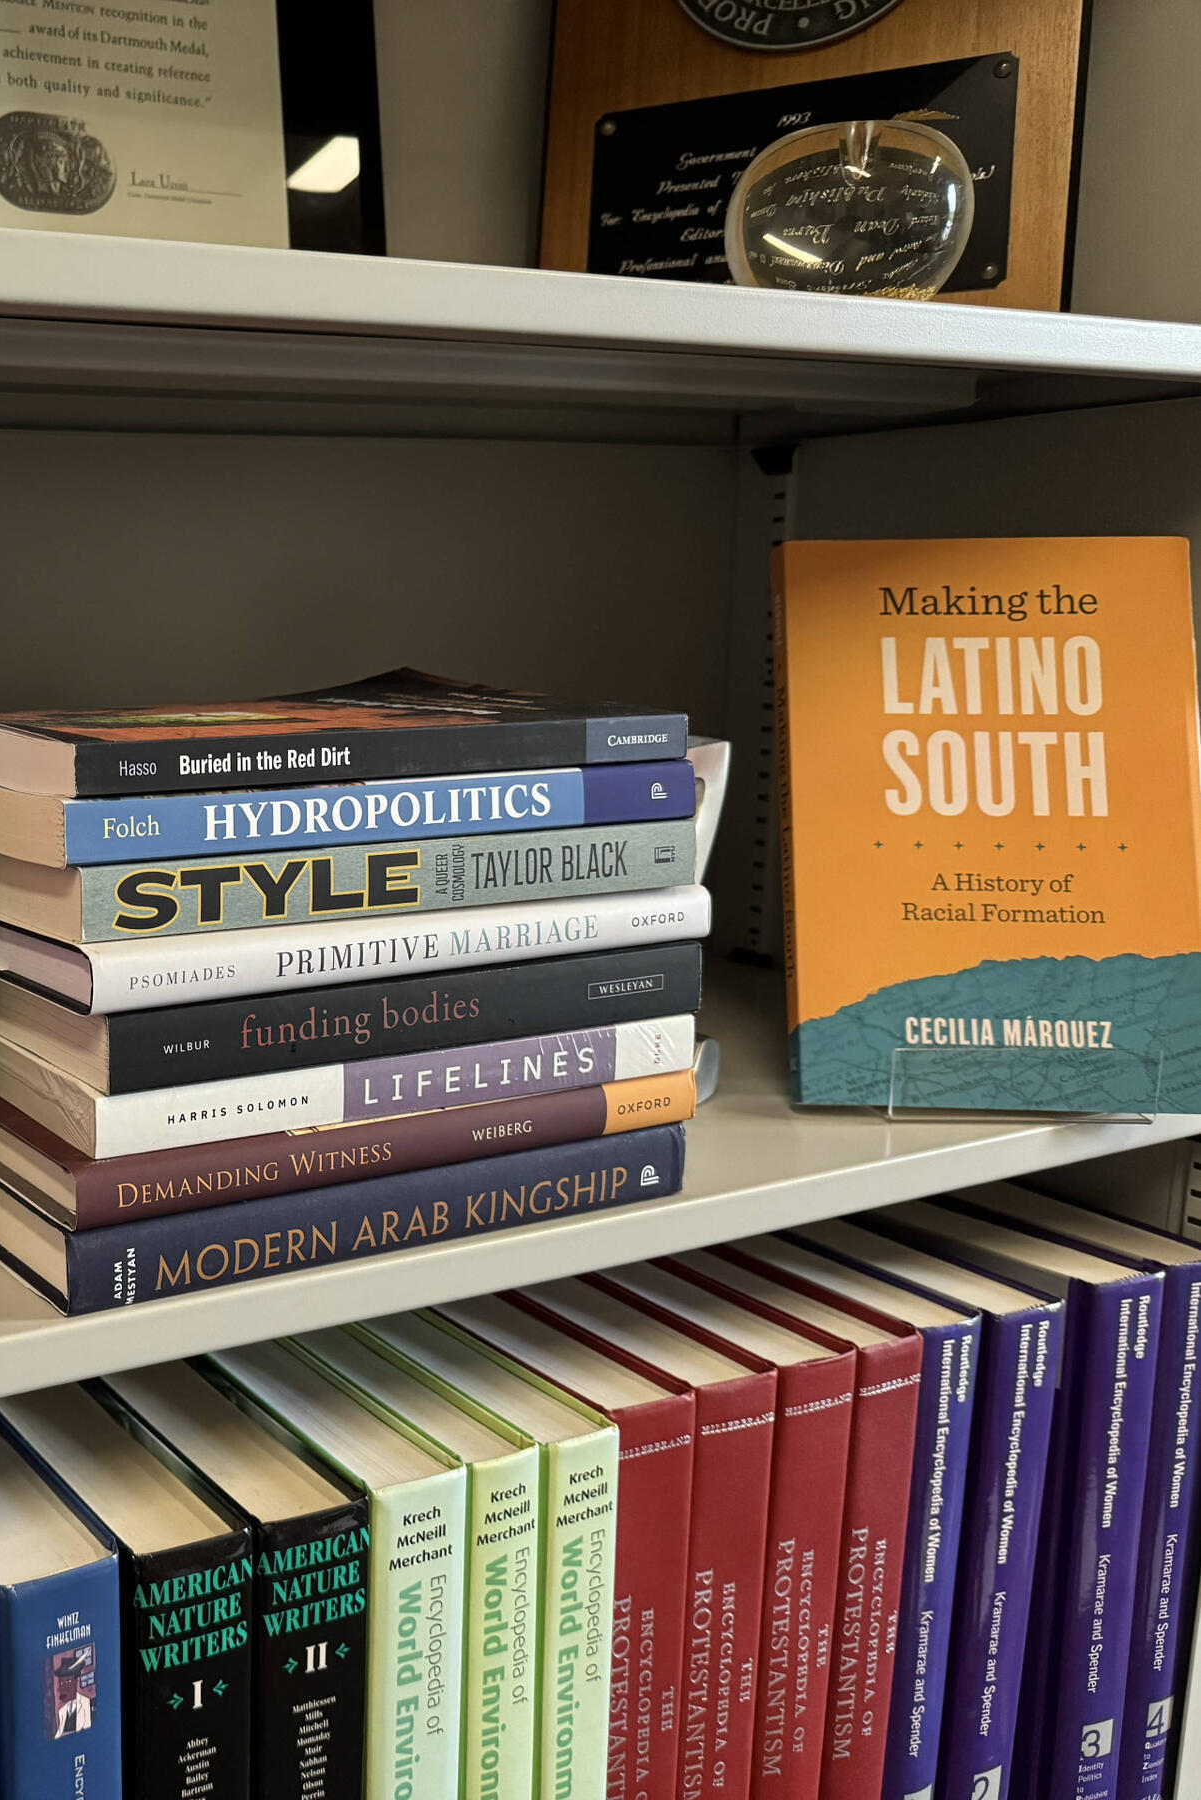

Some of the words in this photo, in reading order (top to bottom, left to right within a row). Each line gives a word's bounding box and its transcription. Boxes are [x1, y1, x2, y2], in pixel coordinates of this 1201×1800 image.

[100, 6, 167, 25] recognition
[173, 14, 184, 27] in
[189, 16, 208, 30] the
[29, 24, 65, 38] award
[68, 27, 79, 40] of
[83, 31, 98, 42] its
[100, 31, 167, 51] Dartmouth
[170, 40, 209, 58] Medal,
[3, 46, 82, 68] achievement
[87, 57, 99, 69] in
[104, 60, 153, 77] creating
[158, 66, 210, 82] reference
[7, 72, 37, 89] both
[44, 80, 91, 96] quality
[97, 86, 119, 98] and
[777, 111, 812, 128] 1993
[677, 147, 757, 170] Government
[656, 175, 721, 195] Presented
[707, 200, 721, 215] of
[619, 254, 698, 274] Professional
[879, 586, 1028, 622] Making
[1036, 585, 1098, 615] the
[881, 635, 1103, 716] LATINO
[607, 734, 668, 746] CAMBRIDGE
[120, 760, 157, 776] Hasso
[179, 753, 232, 776] Buried
[236, 752, 251, 772] in
[256, 751, 282, 770] the
[287, 748, 315, 769] Red
[321, 746, 351, 766] Dirt
[882, 729, 1108, 817] SOUTH
[103, 815, 160, 839] Folch
[203, 782, 552, 842] HYDROPOLITICS
[435, 853, 448, 884] QUEER
[452, 844, 465, 902] COSMOLOGY
[471, 847, 553, 889] TAYLOR
[561, 841, 628, 882] BLACK
[111, 848, 422, 934] STYLE
[435, 885, 448, 895] A
[931, 874, 950, 891] A
[956, 874, 1044, 896] History
[1050, 874, 1074, 893] of
[631, 911, 685, 927] OXFORD
[901, 902, 975, 922] Racial
[981, 904, 1105, 924] Formation
[129, 965, 236, 990] PSOMIADES
[276, 933, 439, 978] PRIMITIVE
[449, 914, 599, 956] MARRIAGE
[599, 979, 653, 994] WESLEYAN
[163, 1039, 210, 1055] WILBUR
[241, 1007, 371, 1049] funding
[383, 990, 480, 1030] bodies
[905, 1017, 994, 1046] CECILIA
[1003, 1016, 1114, 1049] MÁRQUEZ
[364, 1047, 595, 1106] LIFELINES
[167, 1107, 227, 1124] HARRIS
[236, 1095, 309, 1114] SOLOMON
[617, 1097, 671, 1116] OXFORD
[472, 1120, 533, 1141] WEIBERG
[117, 1162, 279, 1208] DEMANDING
[289, 1142, 392, 1176] WITNESS
[155, 1221, 337, 1292] MODERN
[352, 1200, 450, 1251] ARAB
[465, 1167, 627, 1229] KINGSHIP
[113, 1260, 123, 1300] ADAM
[125, 1247, 136, 1305] MESTYAN
[1114, 1299, 1132, 1380] International
[1134, 1295, 1151, 1359] Routledge
[1107, 1381, 1126, 1465] Encyclopedia
[569, 1465, 604, 1485] Krech
[1106, 1467, 1118, 1479] of
[563, 1482, 608, 1506] McNeill
[1102, 1480, 1117, 1529] Women
[403, 1506, 441, 1527] Krech
[556, 1500, 613, 1528] Merchant
[257, 1526, 371, 1576] AMERICAN
[396, 1525, 447, 1549] McNeill
[389, 1544, 452, 1571] Merchant
[133, 1554, 253, 1609] AMERICAN
[272, 1560, 360, 1605] NATURE
[559, 1536, 583, 1636] World
[585, 1529, 606, 1657] Encyclopedia
[1094, 1554, 1111, 1616] Kramarae
[57, 1612, 80, 1629] WINTZ
[149, 1592, 242, 1640] NATURE
[263, 1588, 366, 1637] WRITERS
[863, 1537, 887, 1701] ENCYCLOPEDIA
[46, 1624, 91, 1650] FINKELMAN
[139, 1620, 248, 1673] WRITERS
[396, 1581, 423, 1687] World
[424, 1574, 447, 1709] Encyclopedia
[833, 1525, 868, 1760] PROTESTANTISM
[885, 1610, 898, 1653] THE
[1092, 1619, 1103, 1641] and
[305, 1641, 328, 1674] II
[585, 1662, 601, 1682] of
[762, 1537, 796, 1778] PROTESTANTISM
[1087, 1643, 1103, 1693] Spender
[192, 1679, 203, 1710] I
[305, 1710, 323, 1721] Mills
[426, 1715, 443, 1736] of
[861, 1710, 874, 1736] OF
[1147, 1704, 1164, 1735] 4
[186, 1737, 209, 1750] Abbey
[305, 1744, 322, 1756] Muir
[1083, 1729, 1101, 1758] 3
